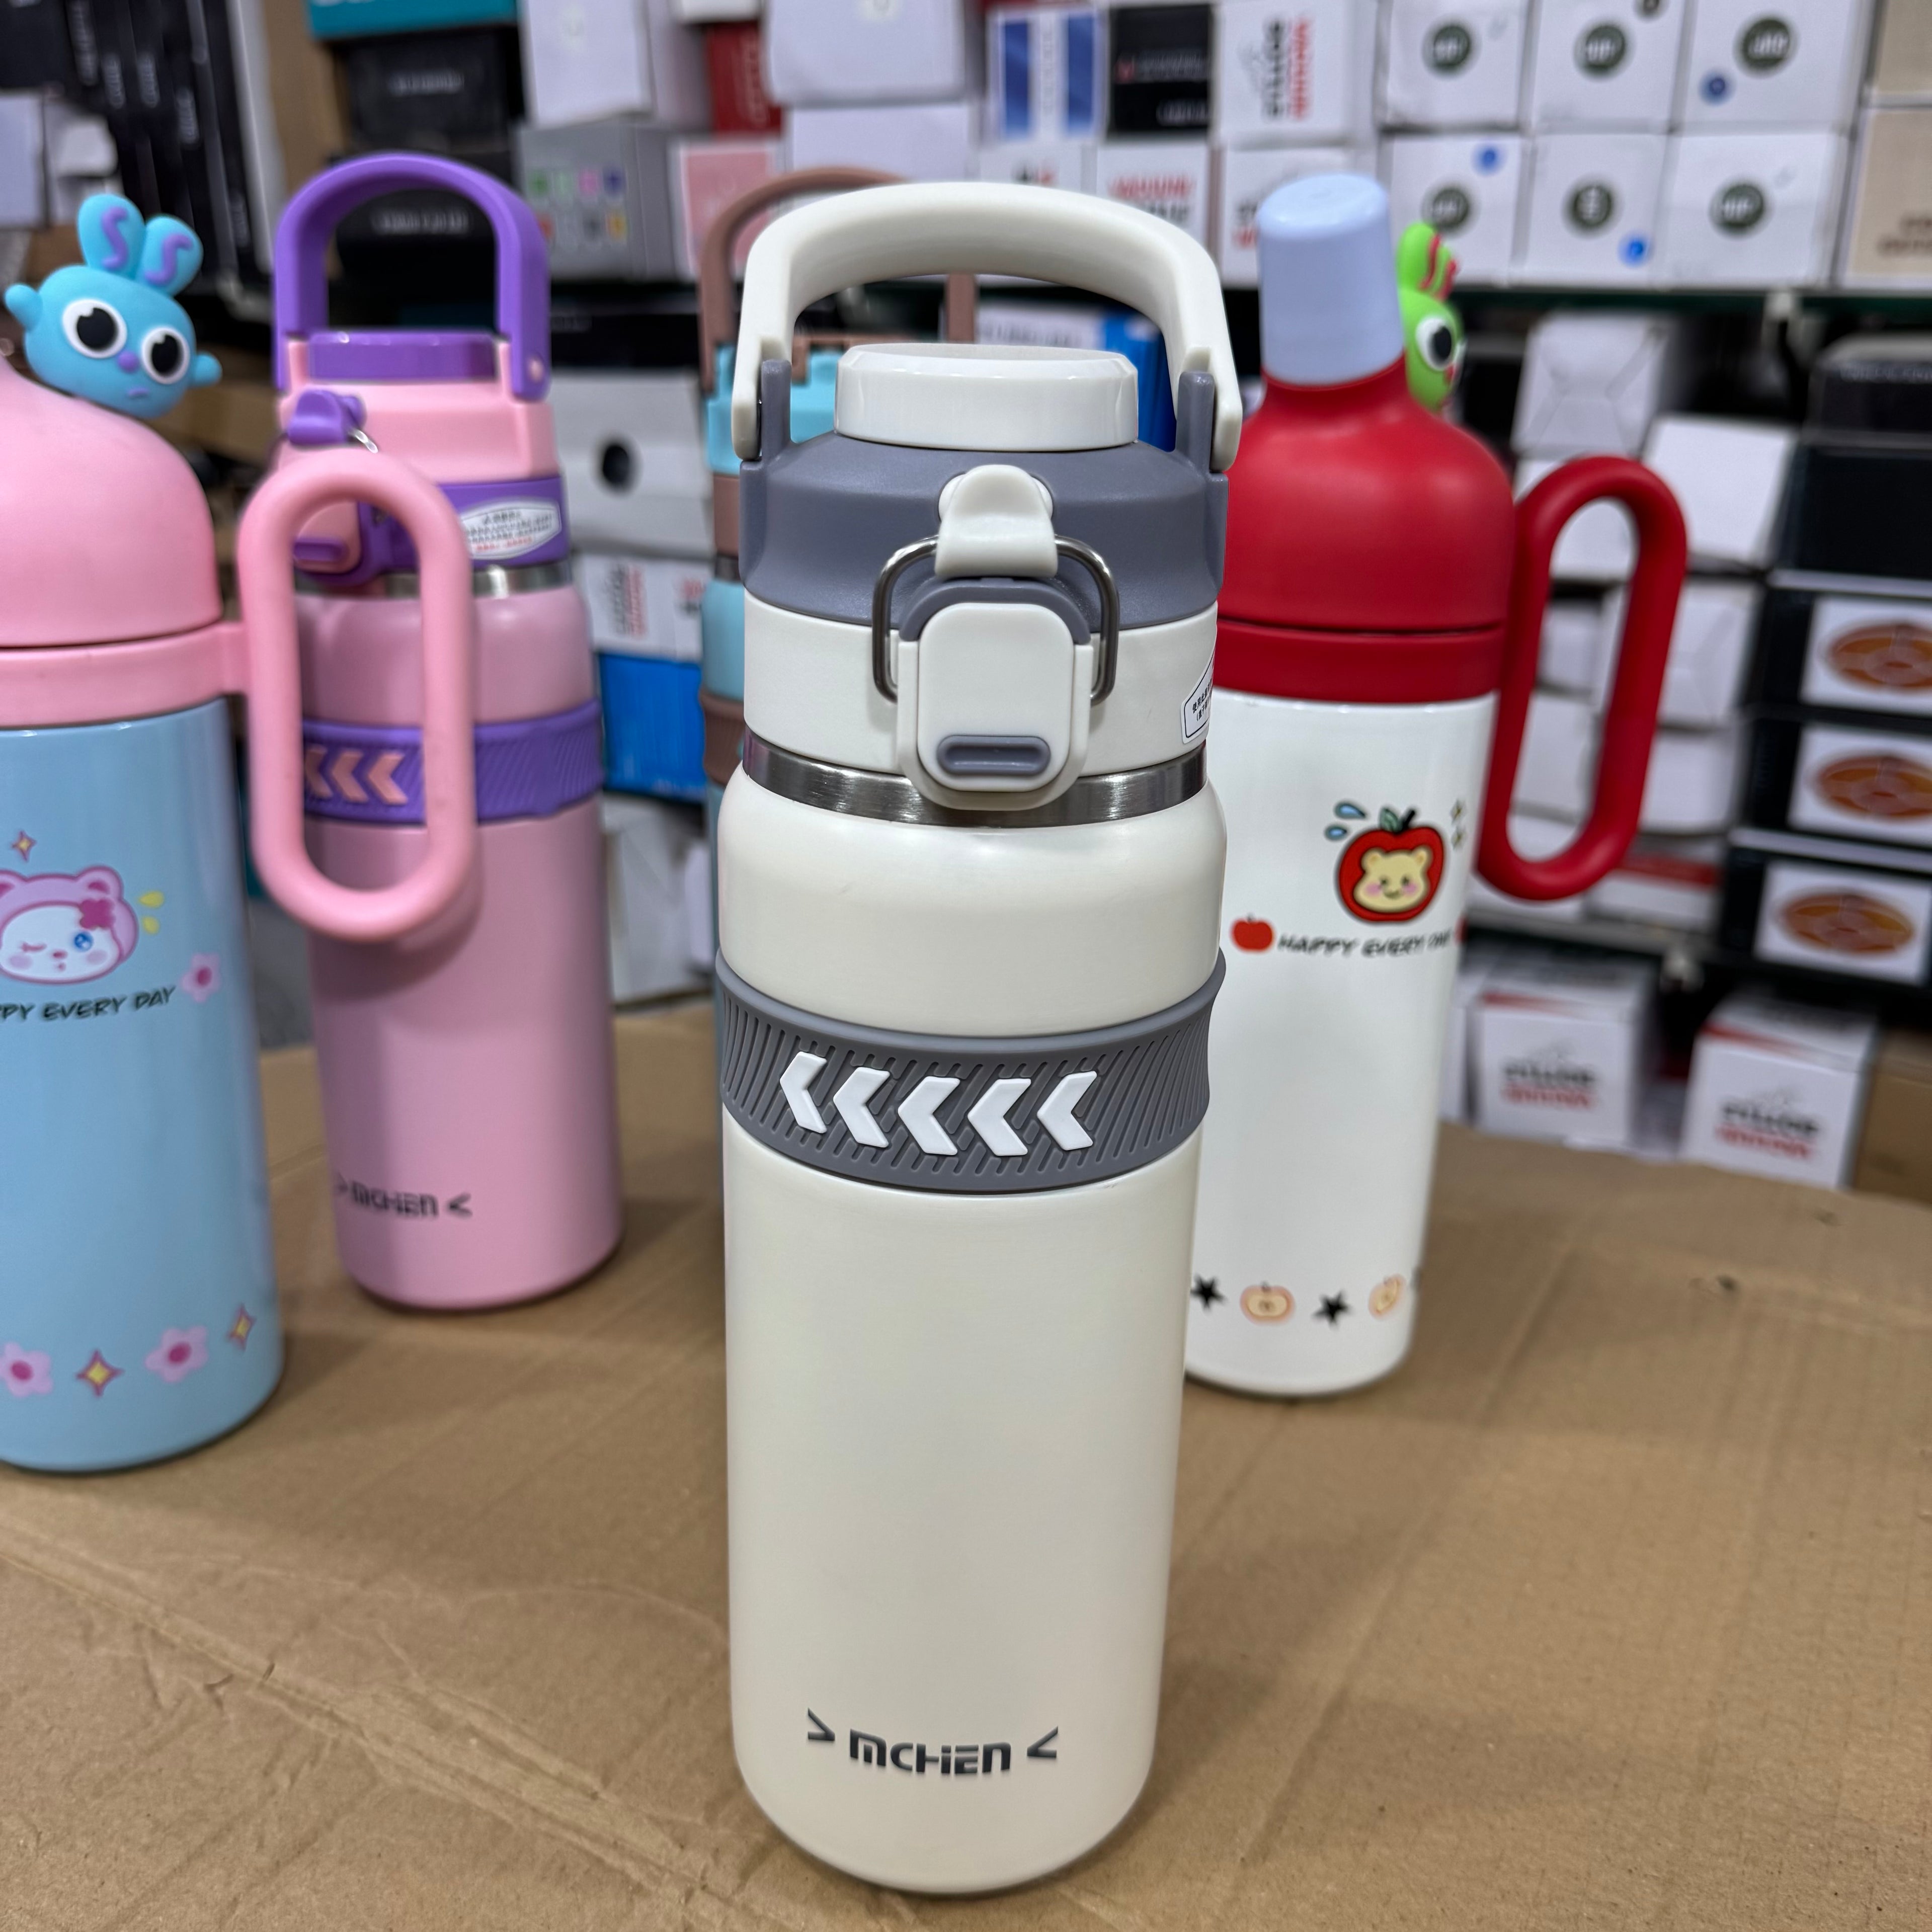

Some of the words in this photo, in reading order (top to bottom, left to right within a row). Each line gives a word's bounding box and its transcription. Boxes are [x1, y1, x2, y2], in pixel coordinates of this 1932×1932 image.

[1277, 934, 1359, 956] HAPPY
[0, 1003, 35, 1020] PY
[41, 996, 127, 1020] EVERY
[133, 985, 176, 1010] DAY
